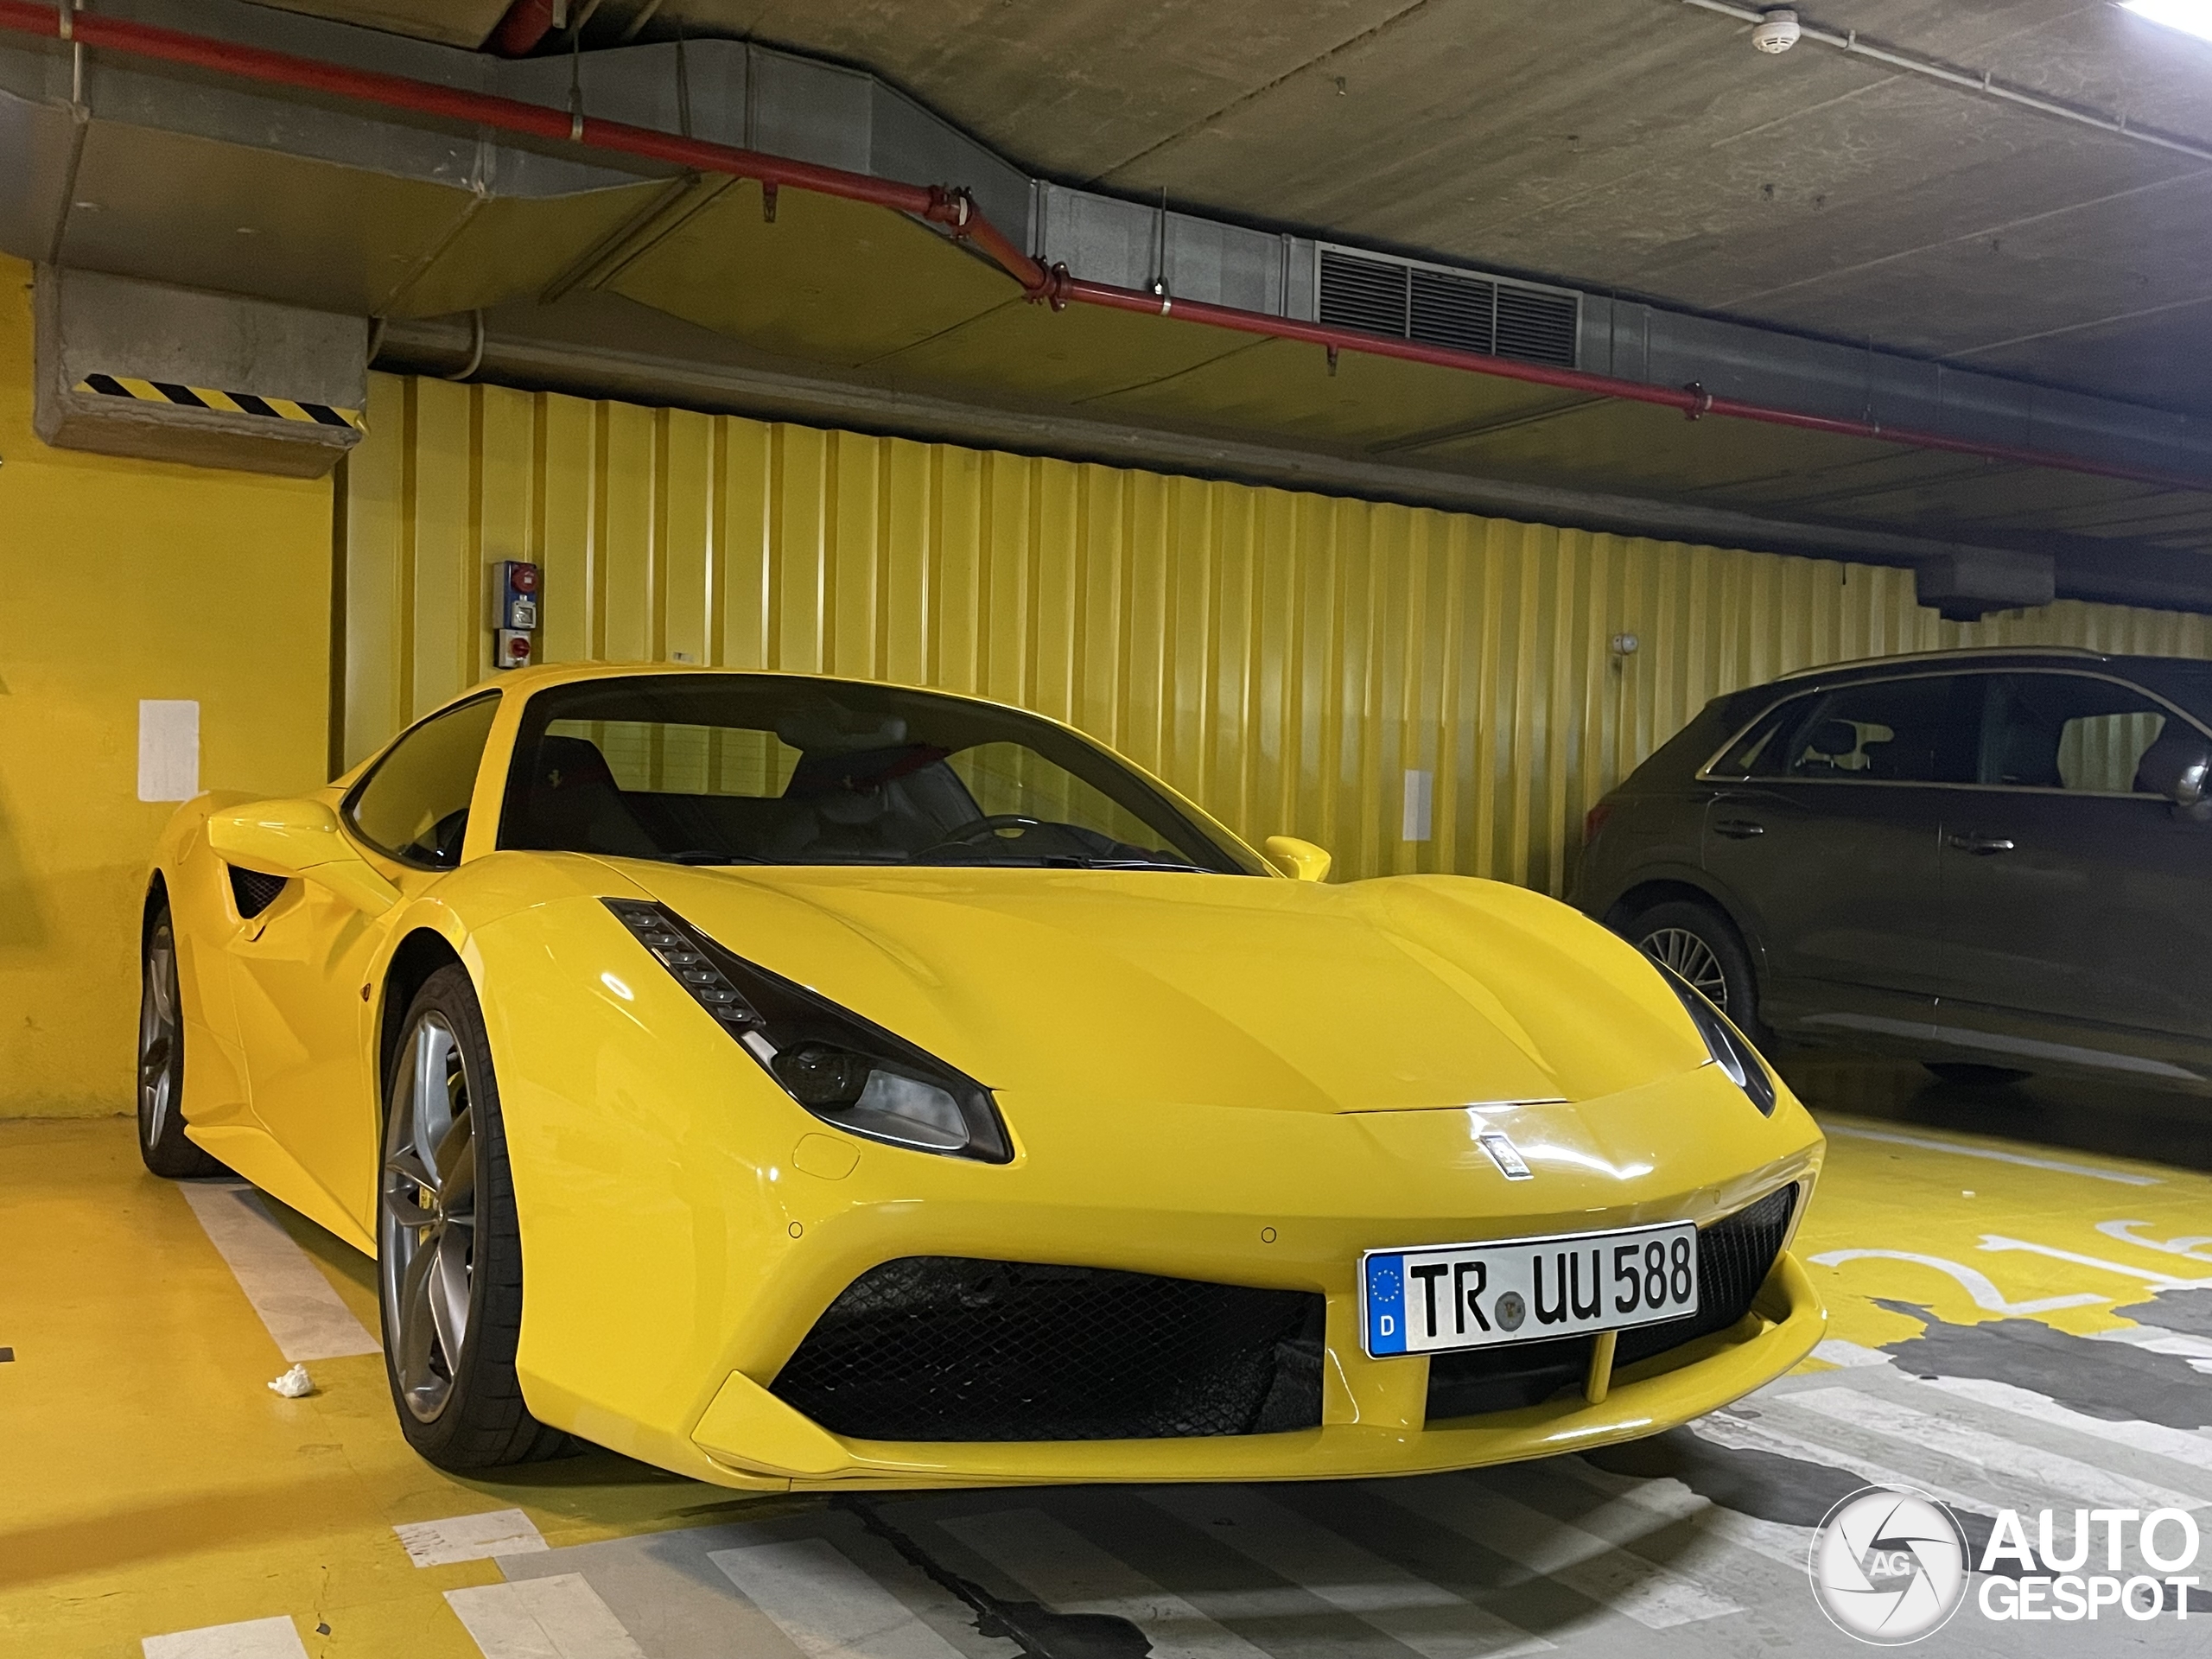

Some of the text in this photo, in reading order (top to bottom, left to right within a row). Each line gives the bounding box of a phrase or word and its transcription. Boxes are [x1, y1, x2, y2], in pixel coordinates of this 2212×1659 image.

[1410, 1236, 1692, 1338] TR UU 588
[1380, 1314, 1395, 1337] D
